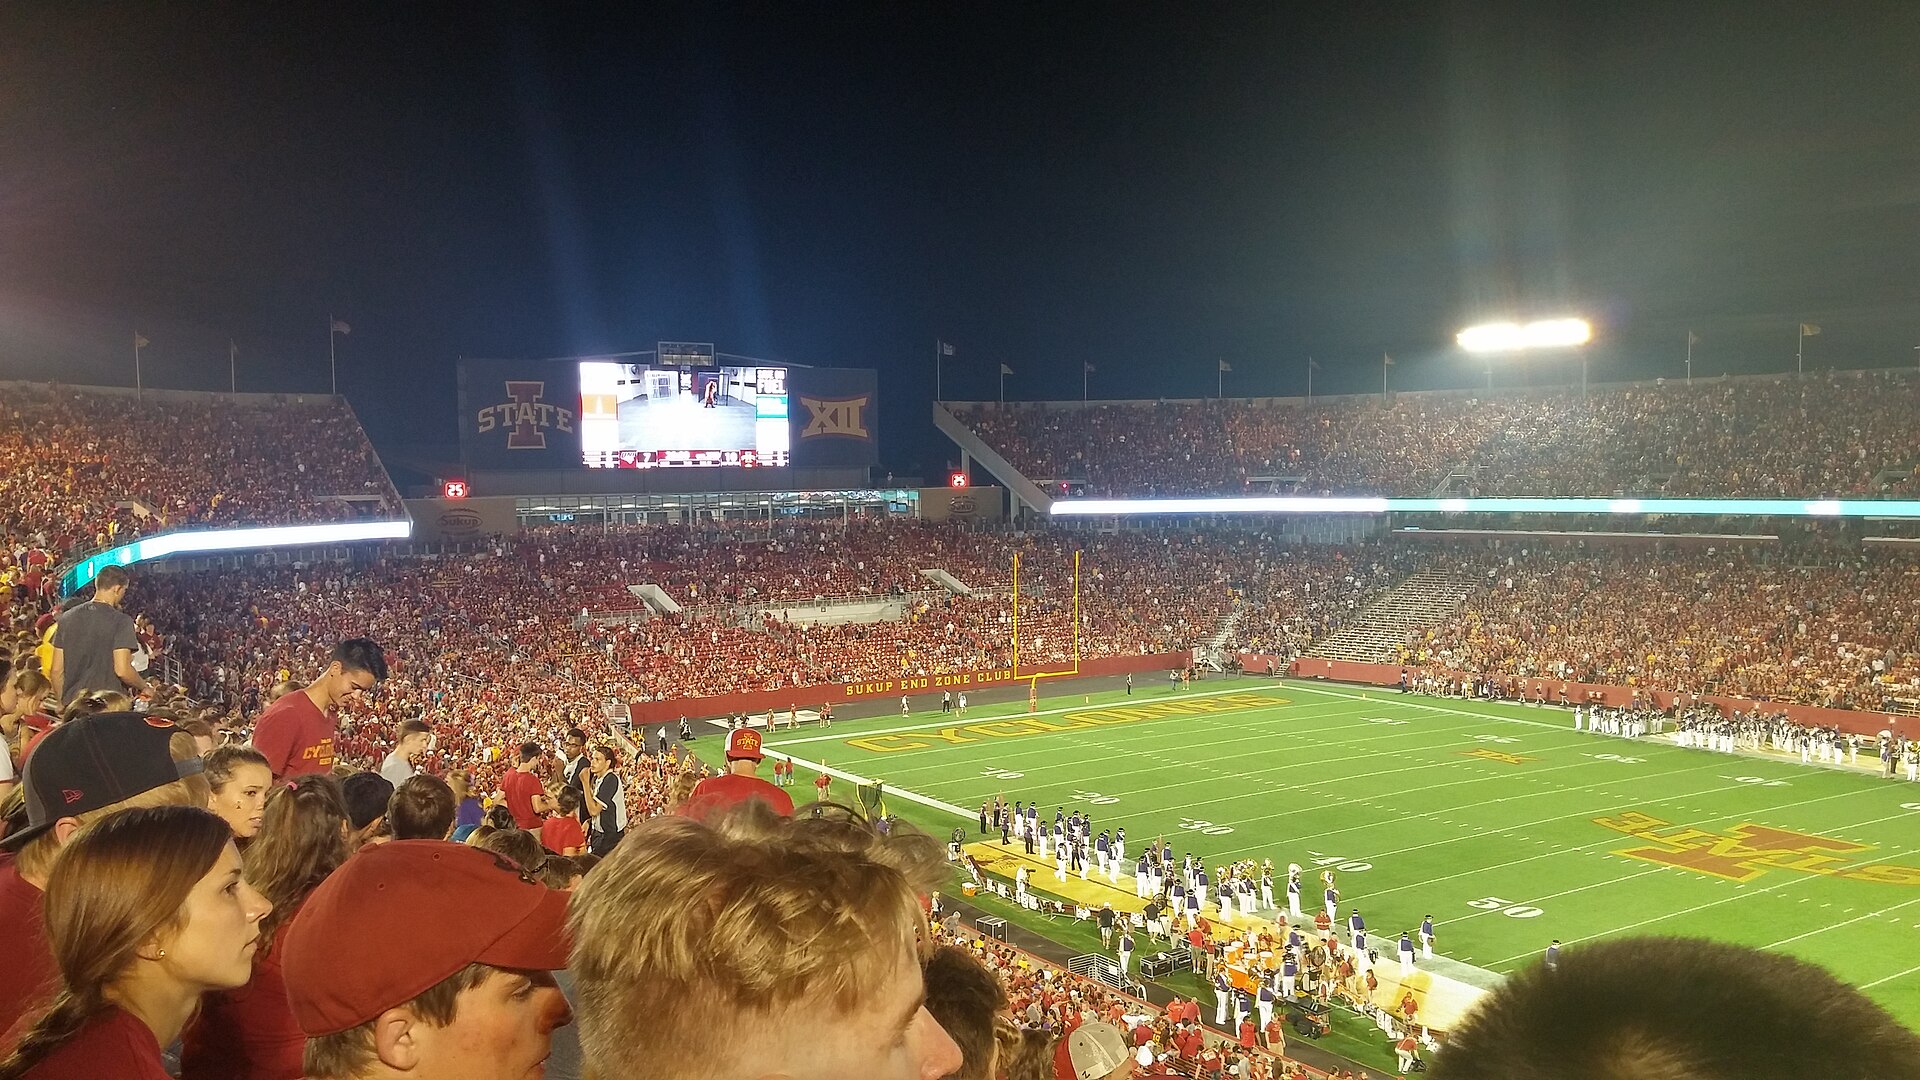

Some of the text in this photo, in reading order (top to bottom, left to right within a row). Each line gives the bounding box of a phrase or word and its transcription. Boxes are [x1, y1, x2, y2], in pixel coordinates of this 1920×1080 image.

[478, 402, 573, 434] STATE
[799, 396, 869, 438] XII
[447, 484, 464, 497] 25
[440, 516, 479, 529] Sukup
[846, 670, 1011, 696] SUKUP END ZONE CLUB
[1467, 896, 1544, 918] 50
